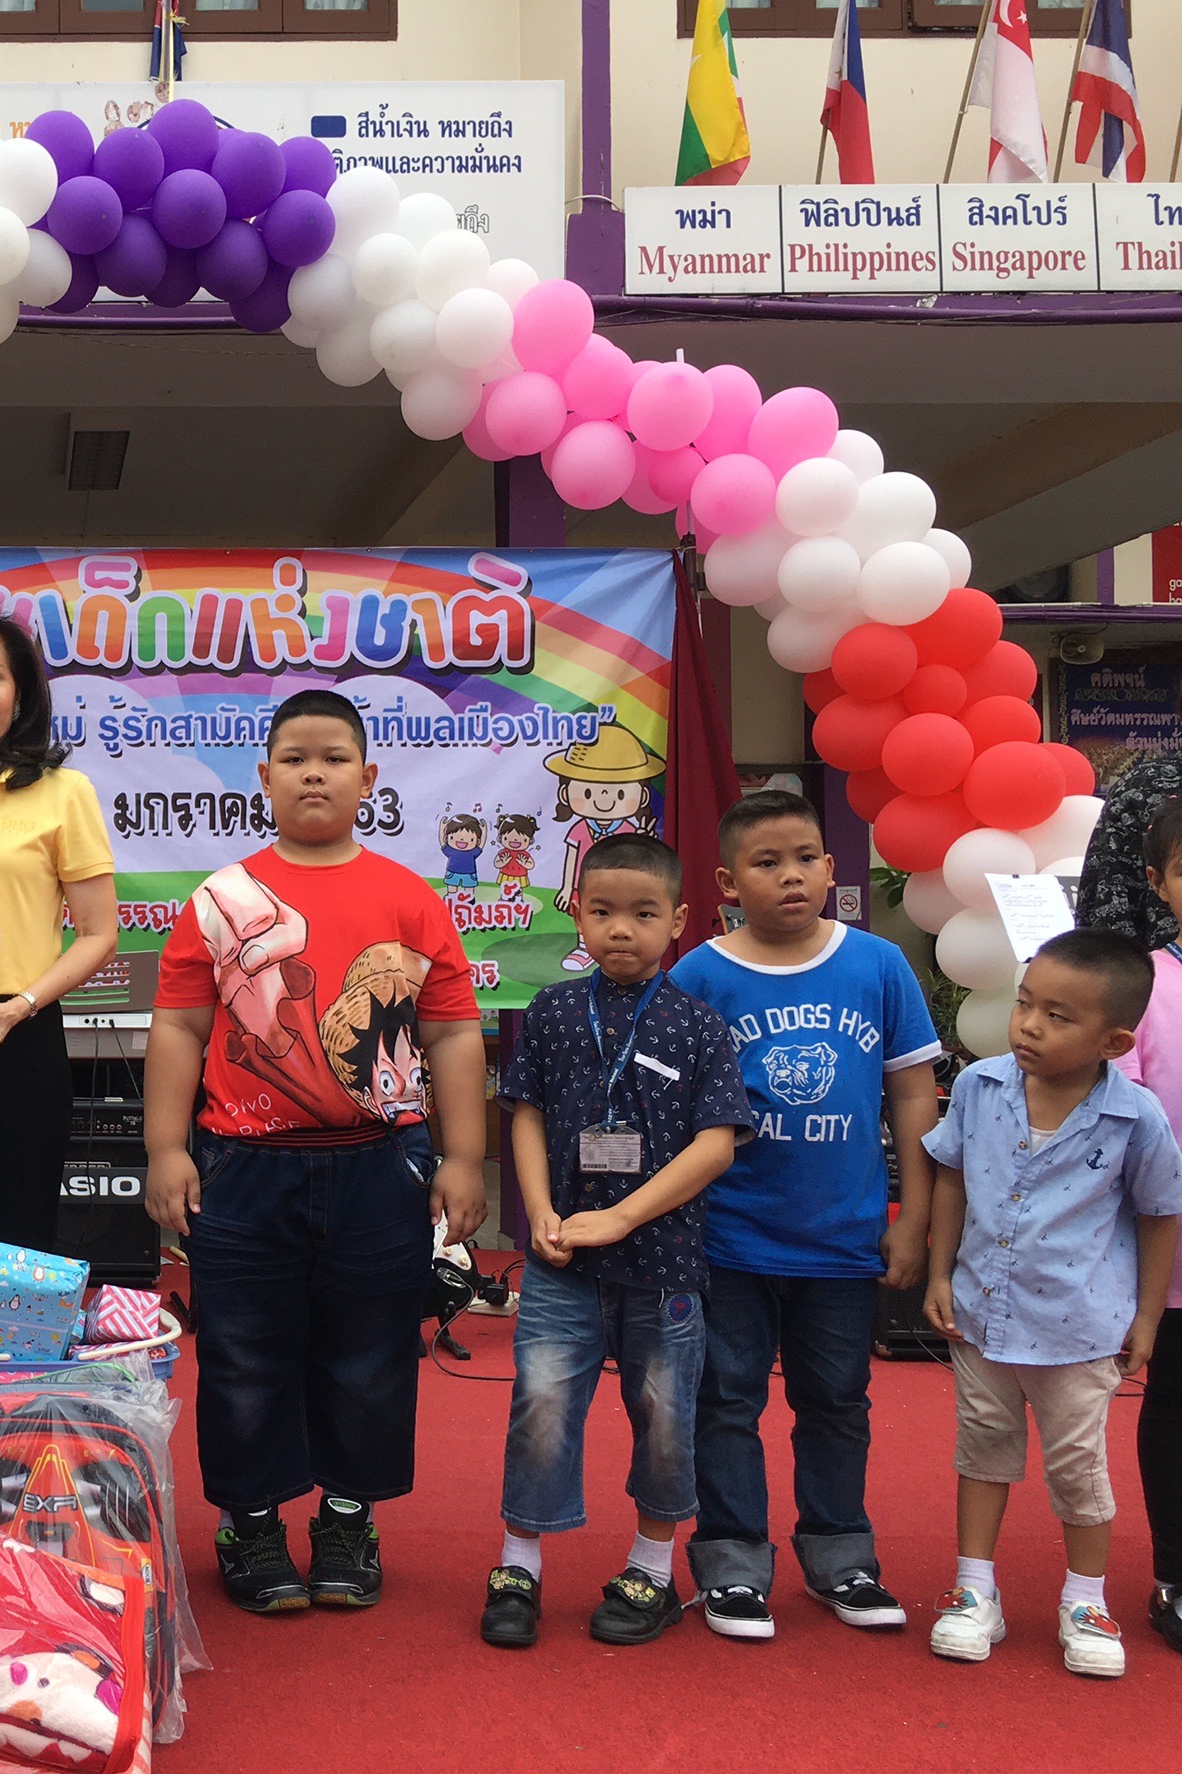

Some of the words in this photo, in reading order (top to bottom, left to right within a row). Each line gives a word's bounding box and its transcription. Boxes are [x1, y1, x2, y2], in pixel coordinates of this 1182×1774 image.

[357, 103, 429, 138] สีน้ำเงิน
[438, 111, 513, 138] หมายถึง
[675, 201, 732, 229] พม่า
[800, 196, 921, 227] ฟิลิปปินส์
[967, 194, 1068, 226] สิงคโปร์
[638, 245, 771, 283] Myanmar
[787, 242, 937, 281] Philippines
[952, 241, 1086, 280] Singapore
[353, 695, 614, 742] ้าที่พลเมืองไทย”
[1070, 705, 1182, 725] ศิษย์วัดมหรรณพา
[114, 792, 276, 833] มกราคม
[765, 1003, 832, 1034] DOGS
[838, 1007, 881, 1053] HYB
[804, 1113, 853, 1142] CITY
